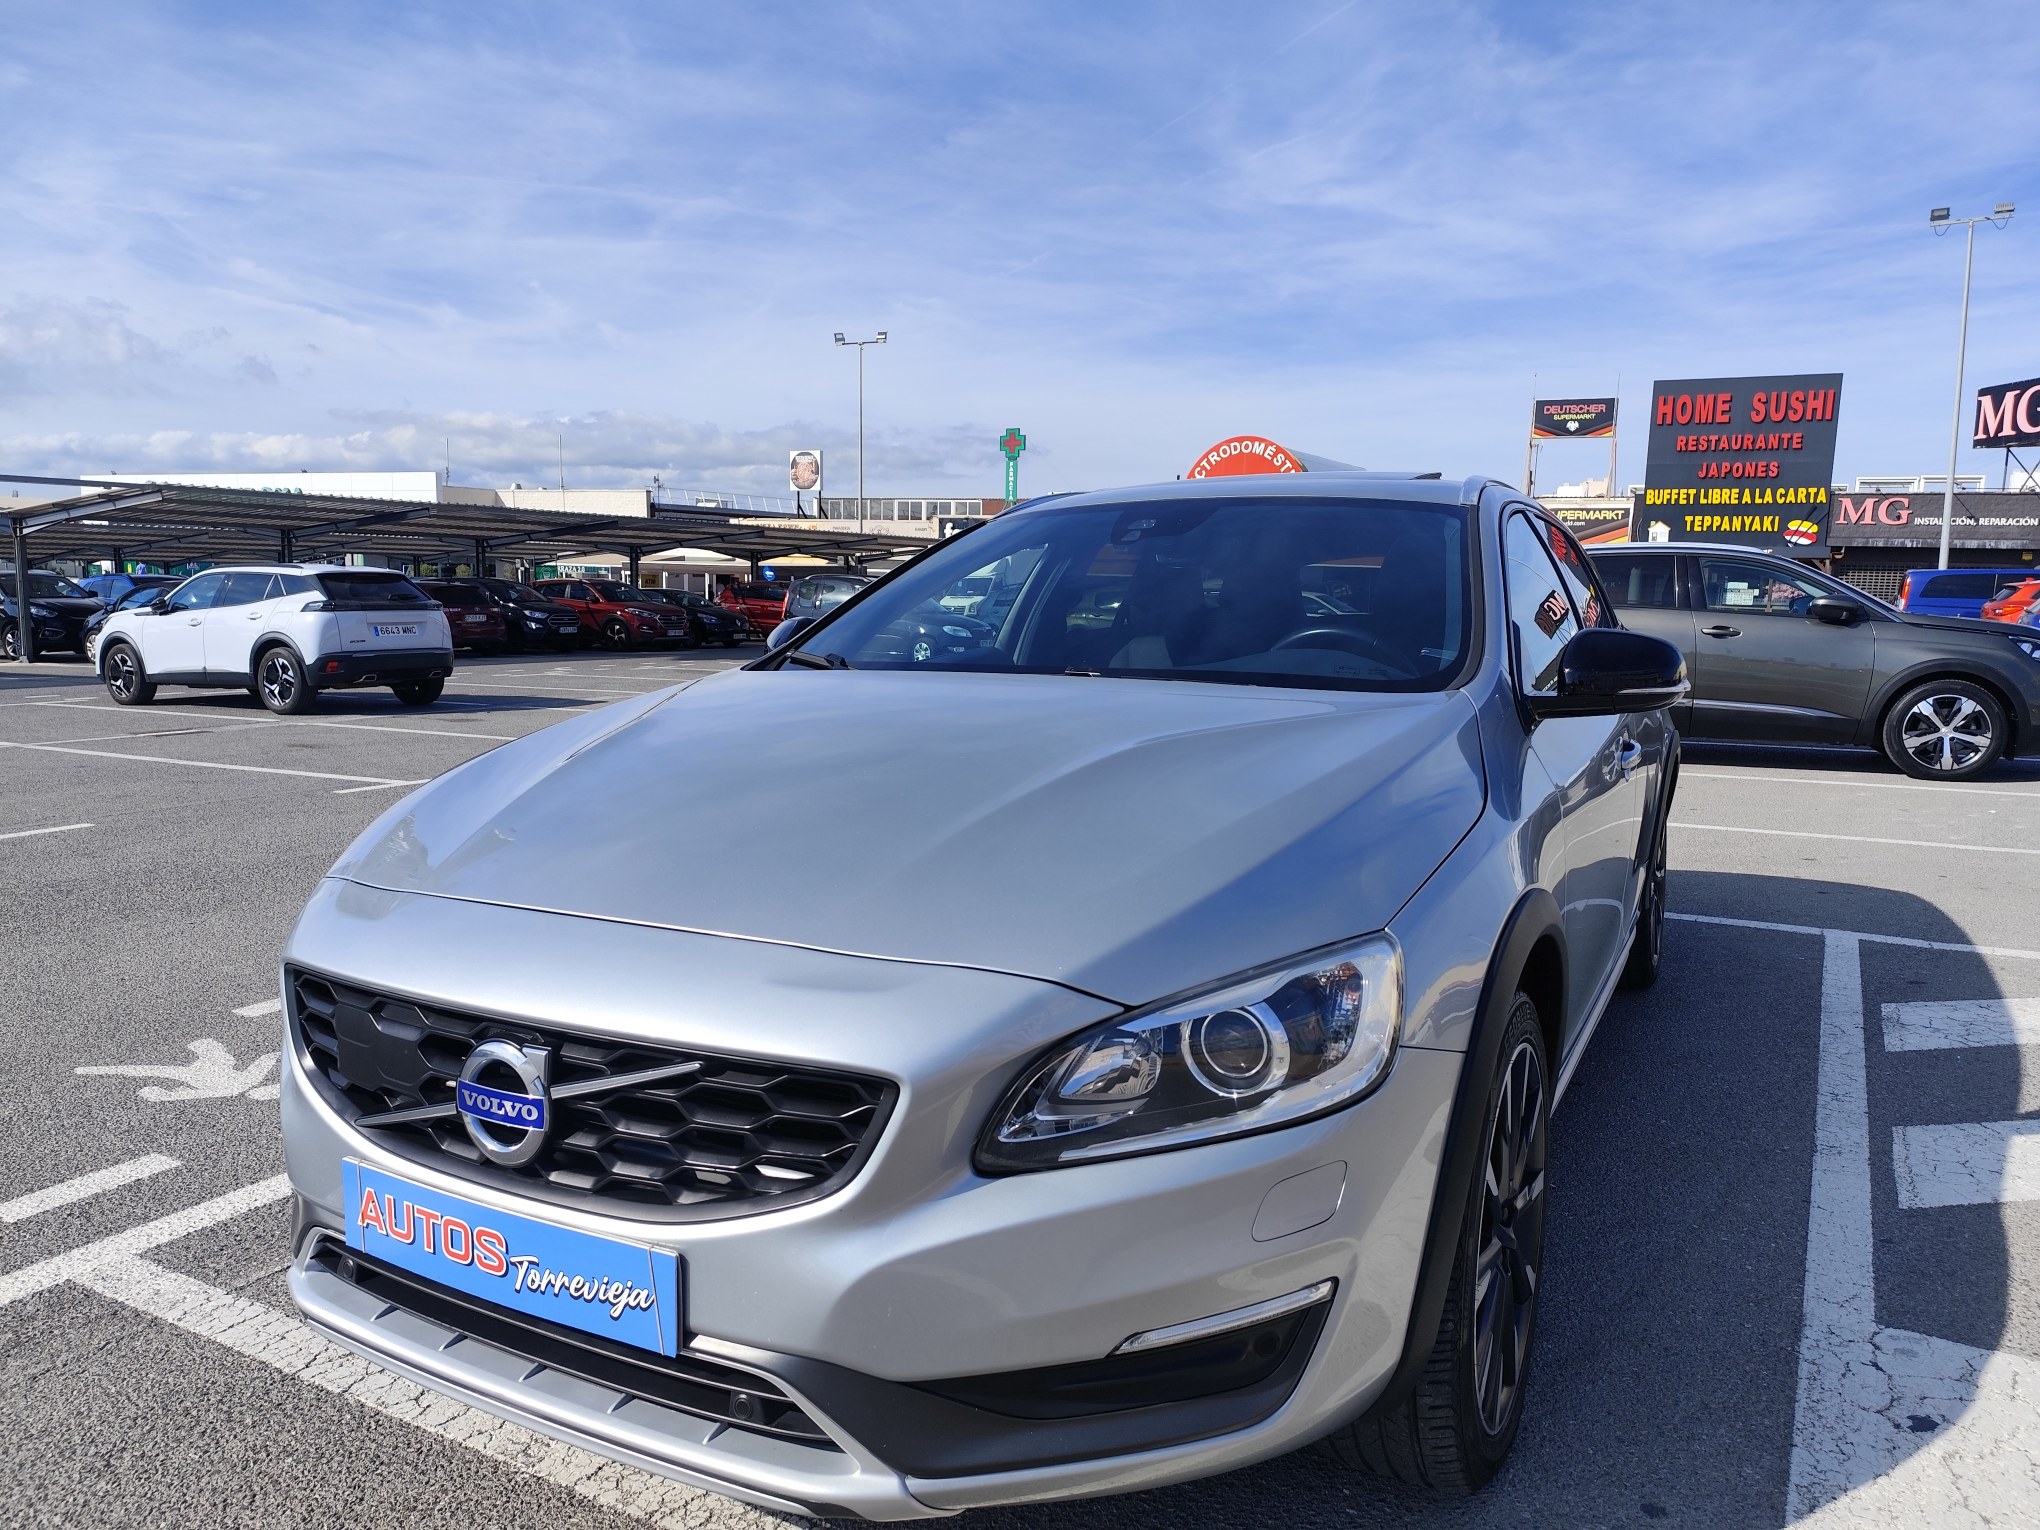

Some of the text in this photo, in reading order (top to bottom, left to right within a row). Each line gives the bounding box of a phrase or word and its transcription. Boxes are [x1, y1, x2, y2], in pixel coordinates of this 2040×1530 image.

[1543, 404, 1606, 415] DEUTSCHER
[1656, 389, 1836, 425] HOME SUSHI
[1553, 413, 1596, 421] SUPERMARKT
[1676, 432, 1804, 452] RESTAURANTE
[1192, 440, 1295, 479] CTRODOMÉST
[1697, 461, 1780, 479] JAPONES
[1645, 487, 1827, 505] BUFFET LIBRE A LA CARTA
[1835, 497, 2039, 527] MG INSTALCIÓN, REPARACIÓN
[1684, 515, 1780, 532] TEPPANYAKI
[380, 626, 401, 635] 6643
[461, 1088, 539, 1120] VOLVO
[357, 1186, 657, 1319] AUTOS Torrevieja
